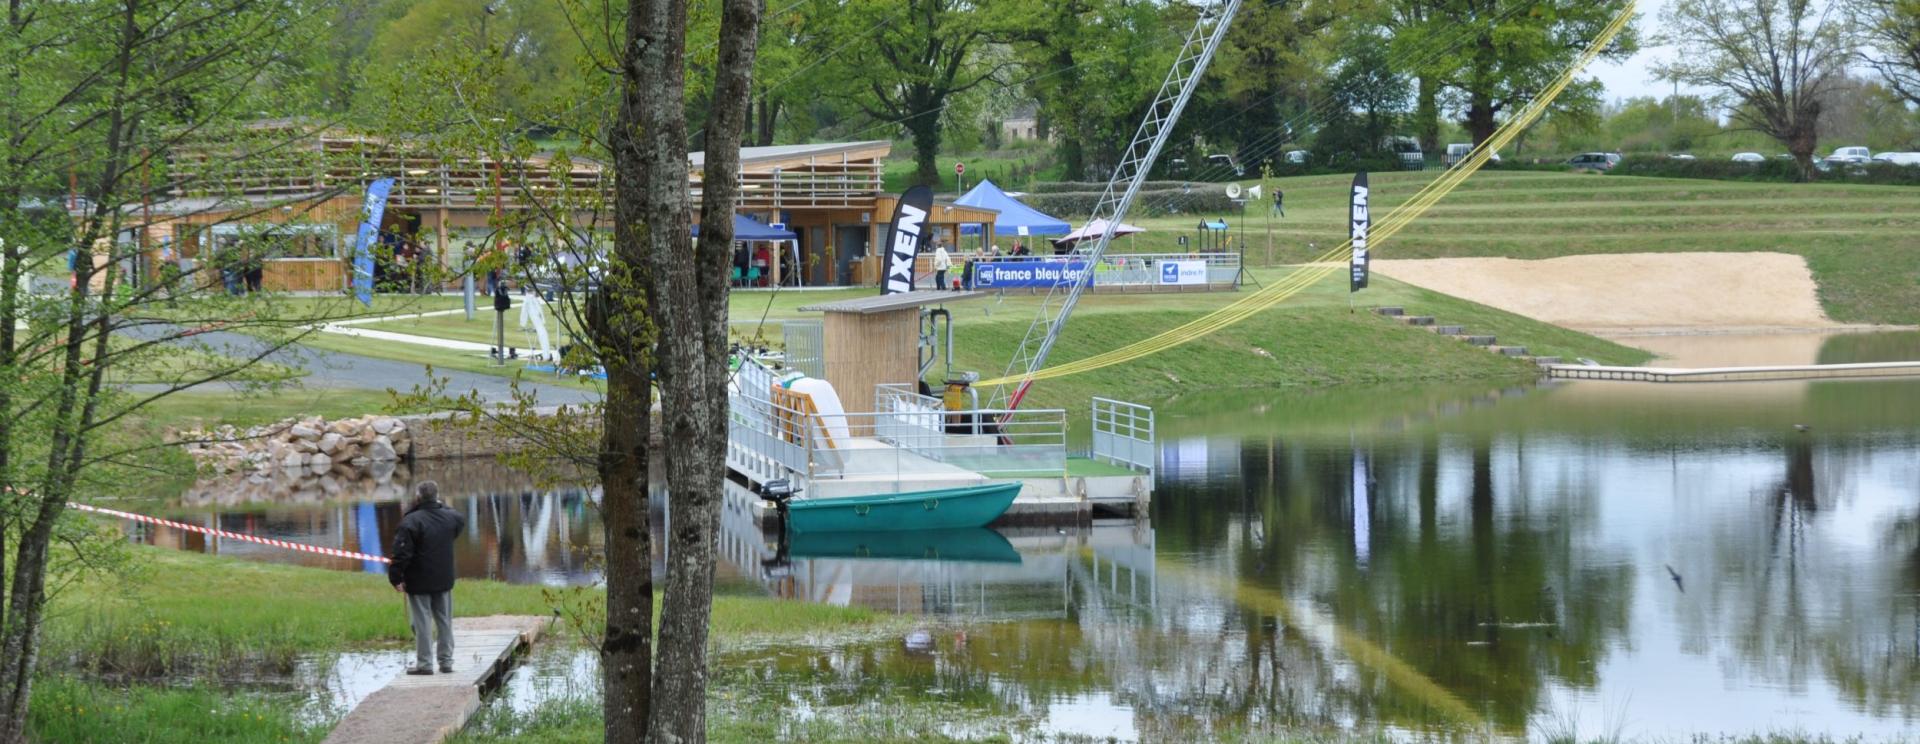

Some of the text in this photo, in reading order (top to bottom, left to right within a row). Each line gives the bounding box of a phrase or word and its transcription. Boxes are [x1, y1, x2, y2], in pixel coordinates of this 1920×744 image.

[888, 204, 927, 295] IXEN
[1352, 185, 1368, 265] RIXEN
[995, 267, 1031, 280] france
[1035, 267, 1060, 280] bleu
